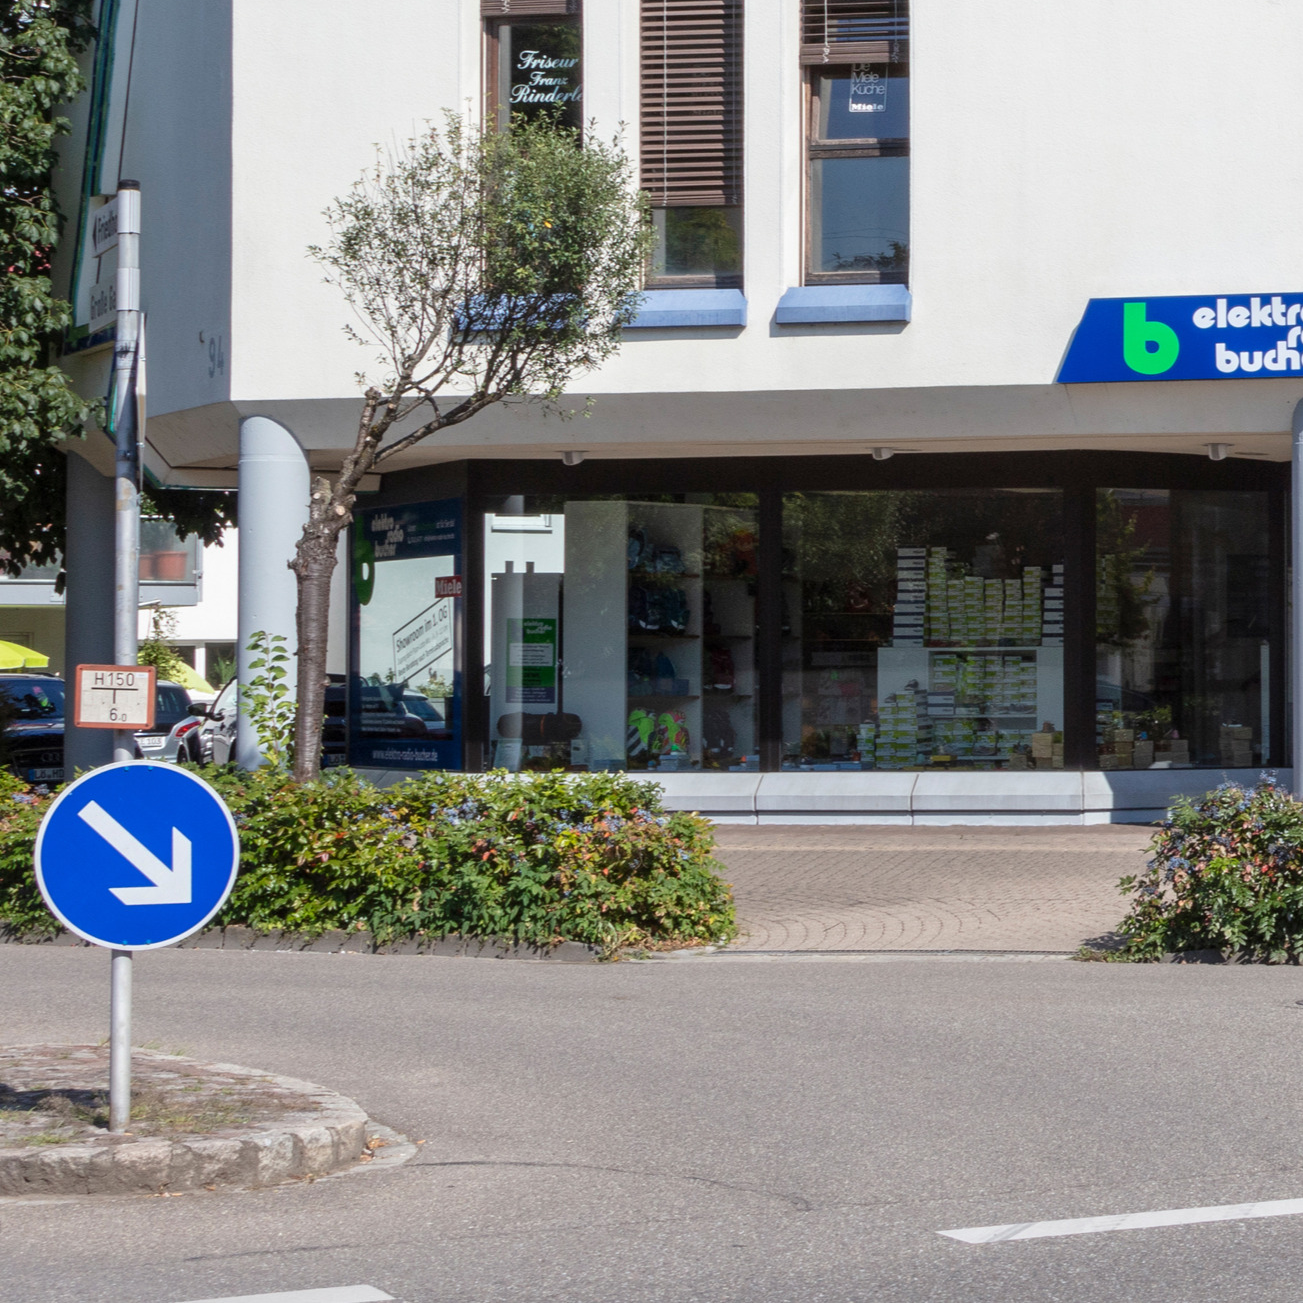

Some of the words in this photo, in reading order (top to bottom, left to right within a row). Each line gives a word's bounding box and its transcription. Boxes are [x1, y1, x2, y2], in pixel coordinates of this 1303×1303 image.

[517, 50, 579, 69] Friseur
[529, 71, 568, 86] Franz
[852, 83, 885, 95] Küche
[851, 103, 884, 111] Miele
[208, 335, 225, 379] 94
[437, 578, 462, 594] Miele
[94, 672, 135, 687] H150
[34, 768, 46, 779] LÖ
